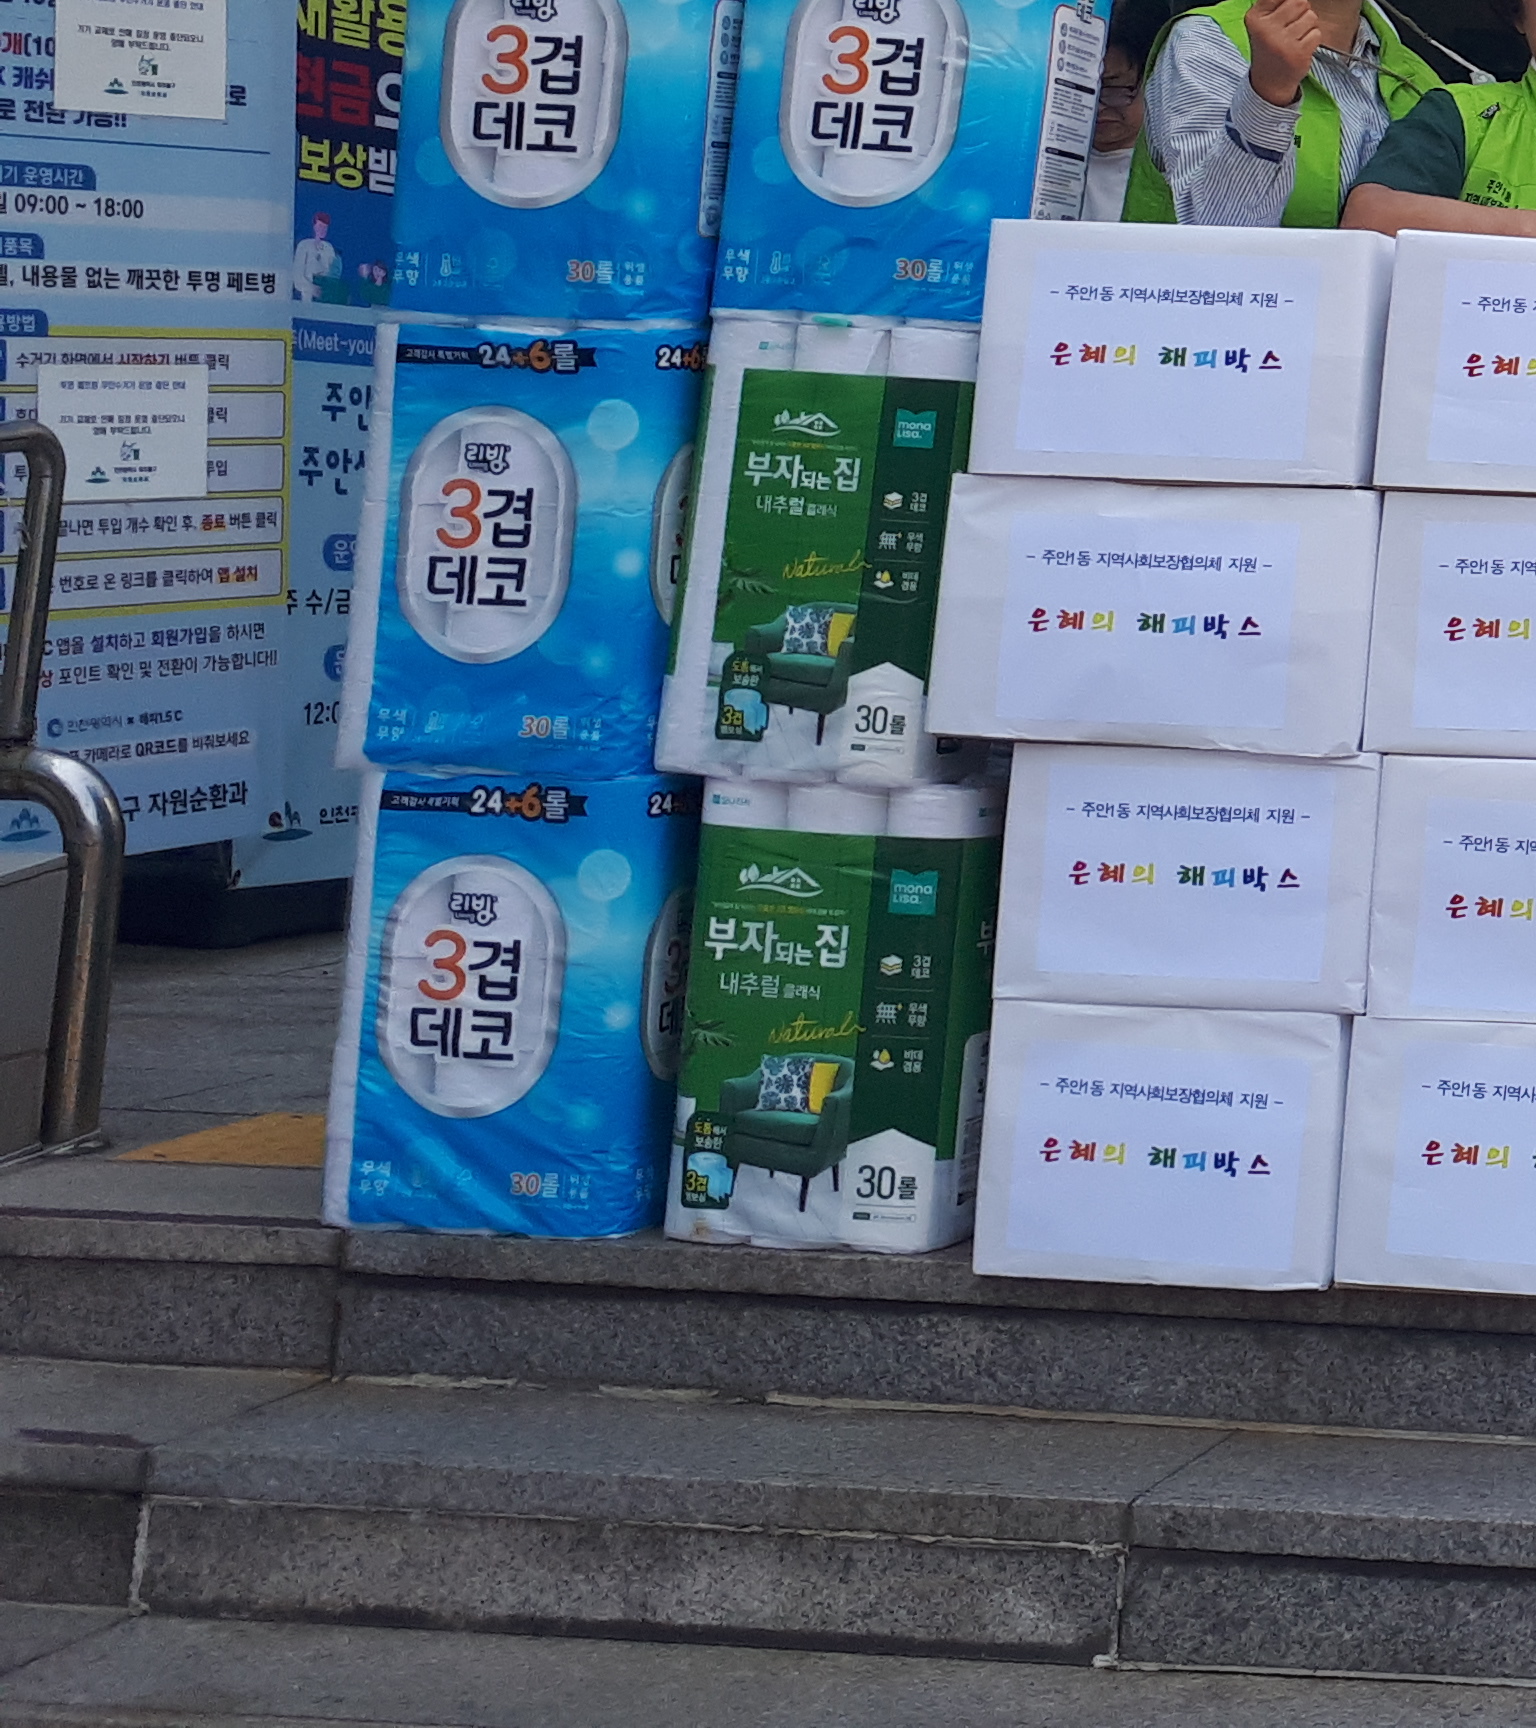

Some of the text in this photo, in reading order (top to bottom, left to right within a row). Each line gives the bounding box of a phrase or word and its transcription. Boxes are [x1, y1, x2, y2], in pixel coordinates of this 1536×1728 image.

[482, 24, 584, 95] 3겹
[822, 26, 925, 95] 3겹
[472, 101, 578, 153] 데코
[810, 100, 914, 152] 데코
[24, 165, 84, 188] 운영시간
[14, 193, 69, 216] 09:00
[94, 197, 144, 220] 18:00
[22, 265, 276, 294] 내용물 없는 깨끗한 투명 페트병
[895, 257, 944, 283] 30롤
[1064, 284, 1279, 309] 주안1동 지역사회보장협의체 지원
[1049, 341, 1283, 374] 은혜의 해피박스
[756, 494, 804, 517] 내추럴
[97, 518, 123, 534] 투입
[125, 516, 150, 533] 개수
[153, 515, 179, 532] 확인
[202, 513, 226, 531] 종료
[229, 513, 251, 530] 버튼
[255, 511, 278, 529] 클릭
[59, 564, 259, 594] 번호로 온 링크를 클릭하여 앱 설치
[1454, 558, 1505, 576] 주안1동
[91, 621, 265, 652] 설치하고 회원가입을 하시면
[1443, 616, 1531, 642] 은혜의
[59, 667, 102, 686] 포인트
[107, 662, 134, 682] 확인
[139, 660, 153, 679] 및
[157, 656, 199, 677] 전환이
[135, 737, 188, 758] QR코드를
[192, 729, 250, 752] 비춰보세요
[148, 780, 249, 815] 자원순환과
[470, 786, 570, 820] 24+6롤
[893, 882, 933, 894] mona
[417, 929, 522, 1002] 3겹
[720, 973, 821, 1001] 내추럴 클래식
[409, 1007, 514, 1063] 데코
[855, 1164, 918, 1202] 30롤
